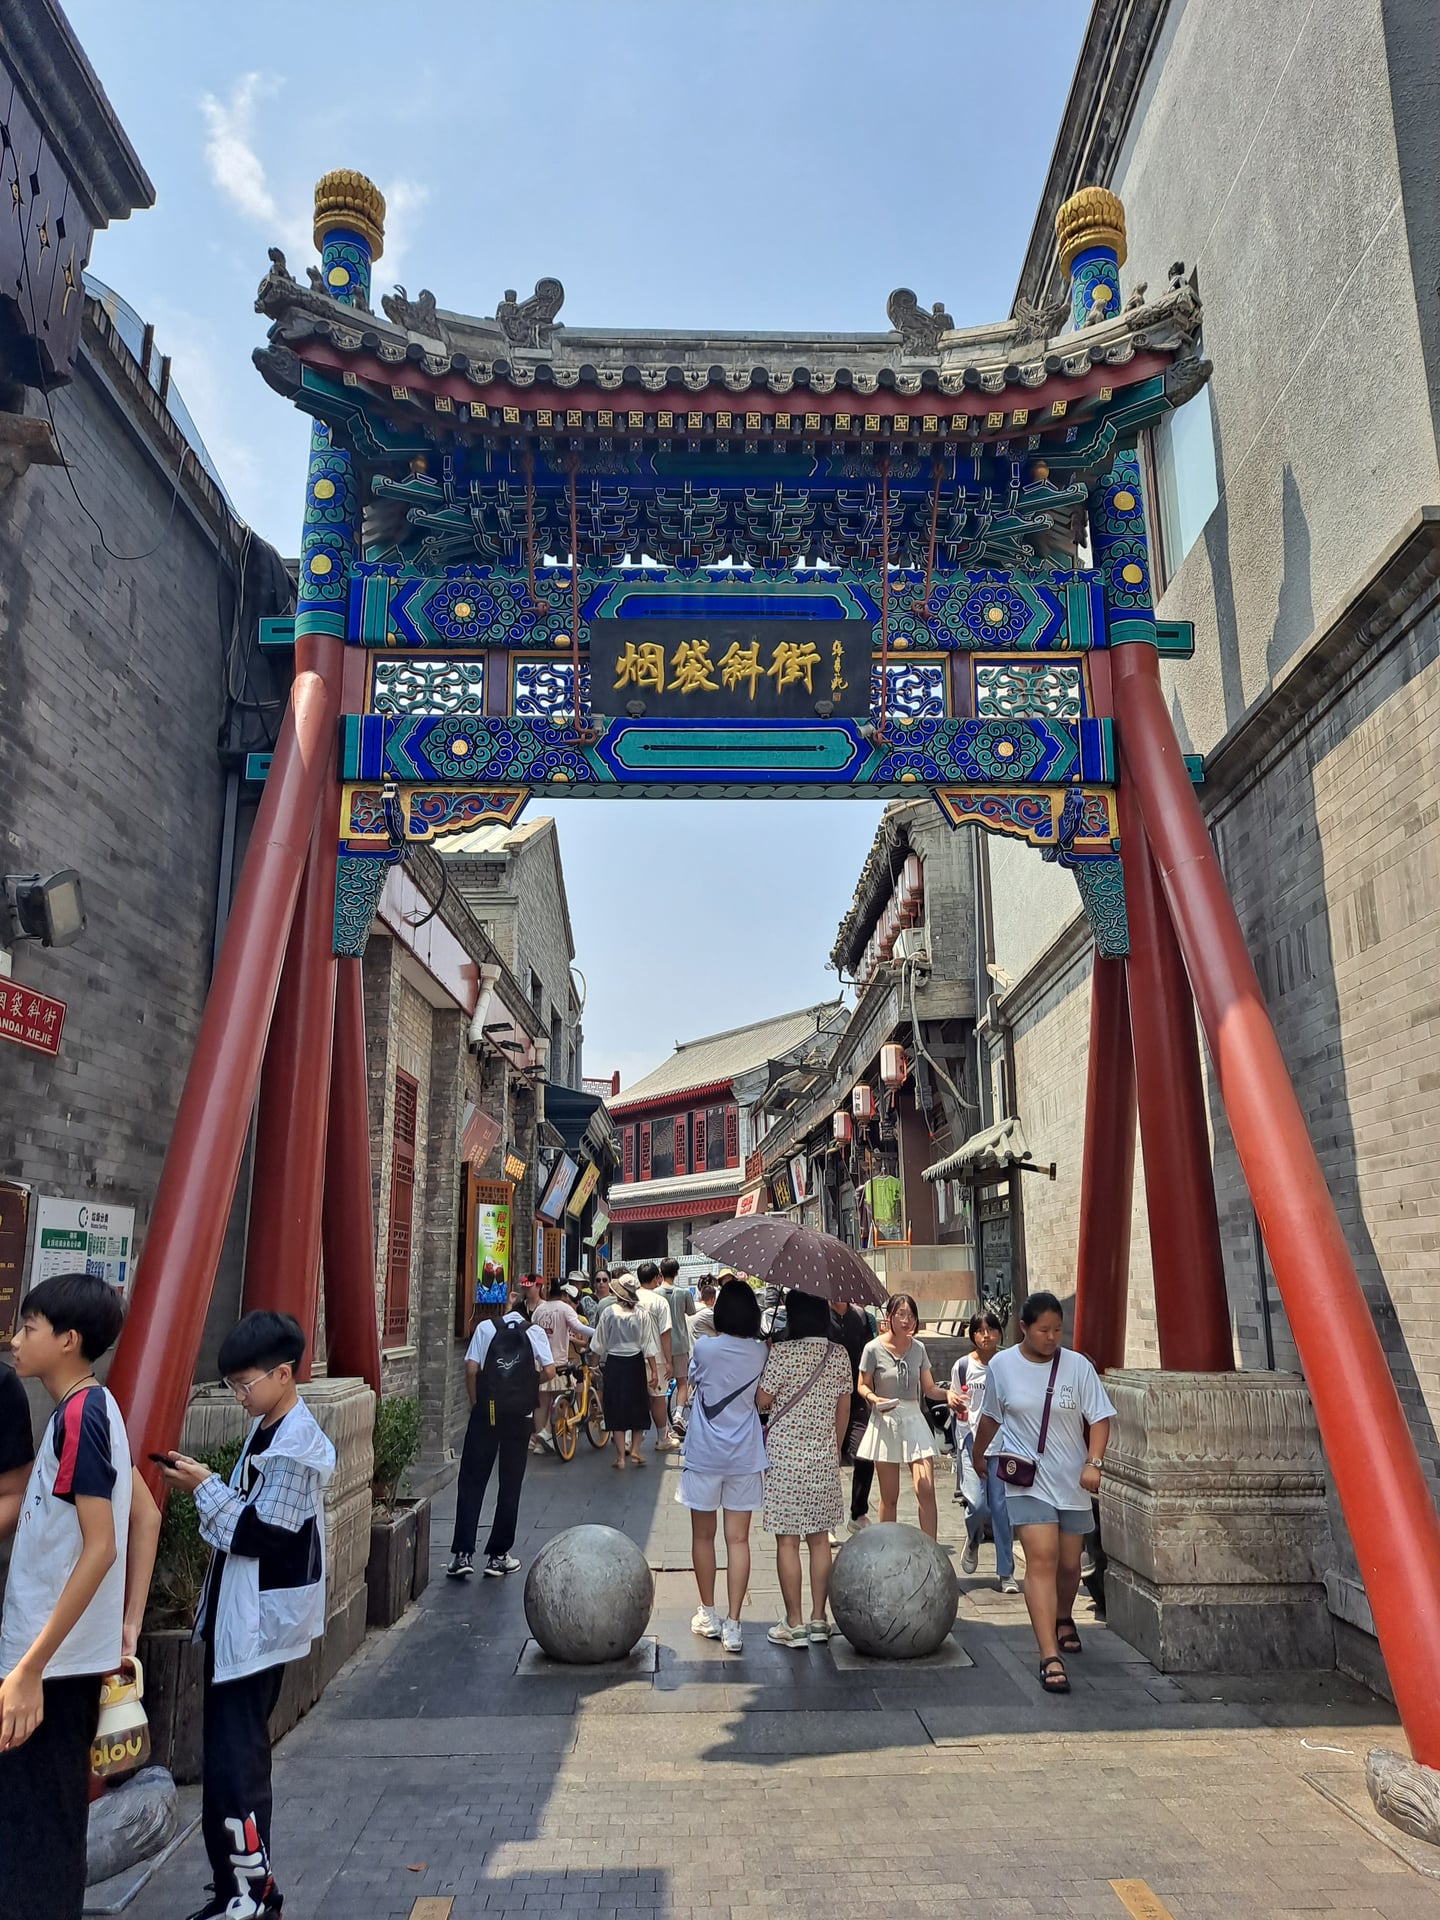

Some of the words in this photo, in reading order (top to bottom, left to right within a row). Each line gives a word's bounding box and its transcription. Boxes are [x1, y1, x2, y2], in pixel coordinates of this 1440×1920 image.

[612, 639, 822, 701] 烟袋斜街
[0, 1017, 24, 1035] NDAI
[26, 1027, 53, 1046] XIEJIE
